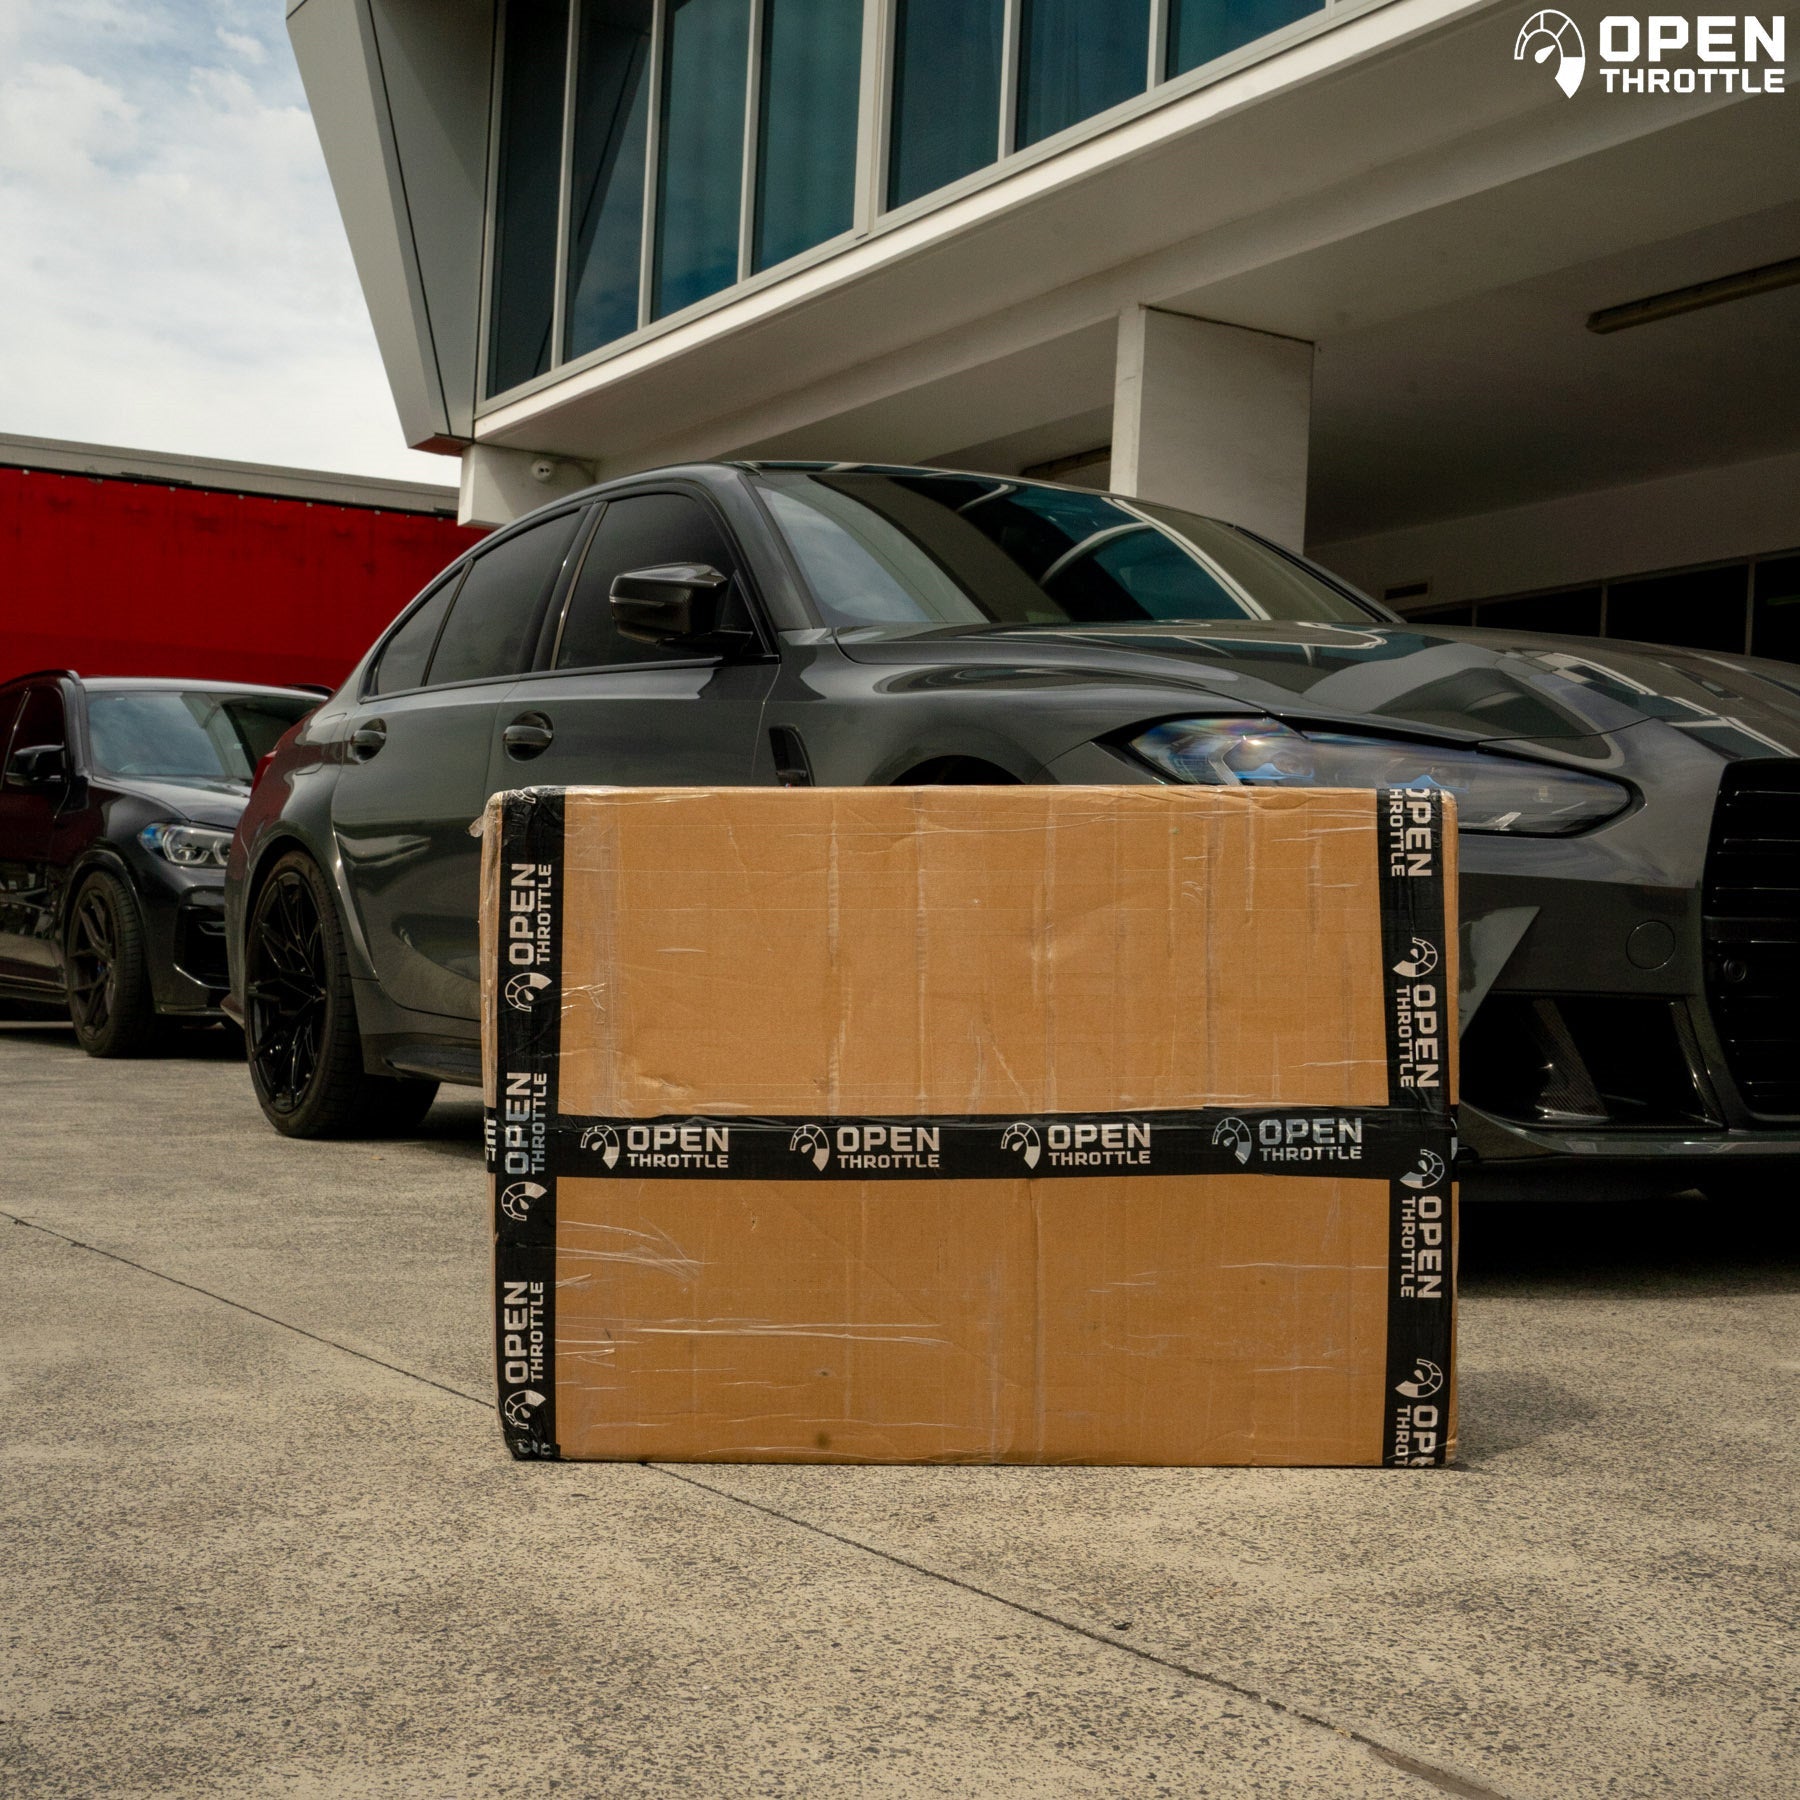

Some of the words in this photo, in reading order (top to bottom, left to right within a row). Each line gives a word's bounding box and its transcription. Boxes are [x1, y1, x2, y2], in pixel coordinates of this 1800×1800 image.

[1389, 788, 1405, 877] HROTTLE
[509, 864, 535, 964] OPEN
[536, 864, 551, 965] THROTTLE
[1396, 985, 1414, 1087] THROTTLE
[1413, 985, 1440, 1087] OPEN
[505, 1073, 531, 1174] OPEN
[531, 1073, 547, 1175] THROTTLE
[627, 1126, 729, 1152] OPEN
[627, 1154, 728, 1168] THROTTLE
[837, 1126, 940, 1152] OPEN
[838, 1155, 939, 1168] THROTTLE
[1048, 1123, 1150, 1149] OPEN
[1048, 1152, 1151, 1166] THROTTLE
[1259, 1118, 1362, 1144] OPEN
[1259, 1147, 1362, 1161] THROTTLE
[1401, 1197, 1415, 1297] THROTTLE
[1418, 1196, 1441, 1297] OPEN
[504, 1282, 528, 1383] OPEN
[530, 1282, 543, 1381] THROTTLE
[1394, 1405, 1411, 1466] THROT
